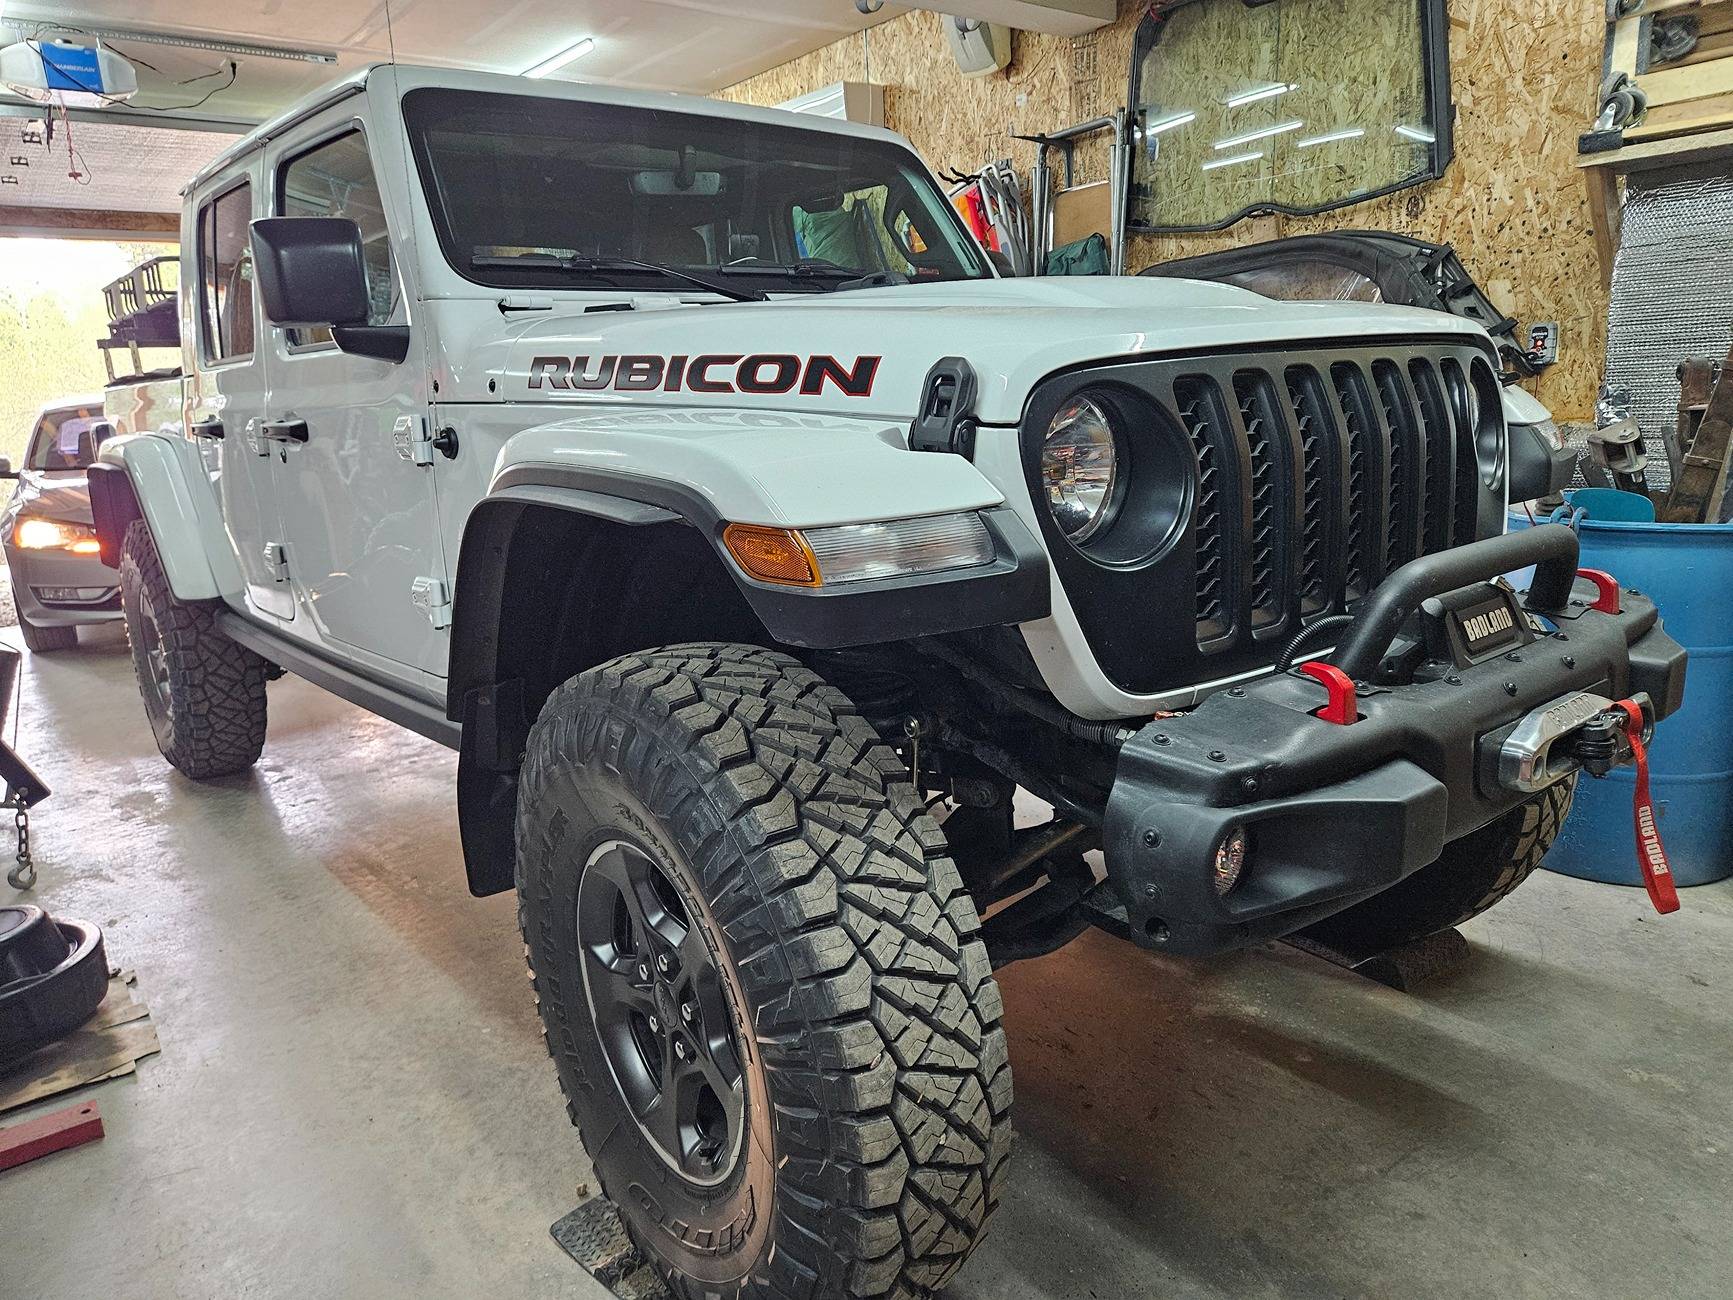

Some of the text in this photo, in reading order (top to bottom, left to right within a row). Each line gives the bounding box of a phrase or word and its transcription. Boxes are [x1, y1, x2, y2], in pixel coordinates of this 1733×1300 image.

[52, 63, 96, 73] HAMBERLAIN
[528, 354, 882, 397] RUBICON
[1463, 606, 1513, 642] BADLAND
[1638, 805, 1669, 875] BADLAND
